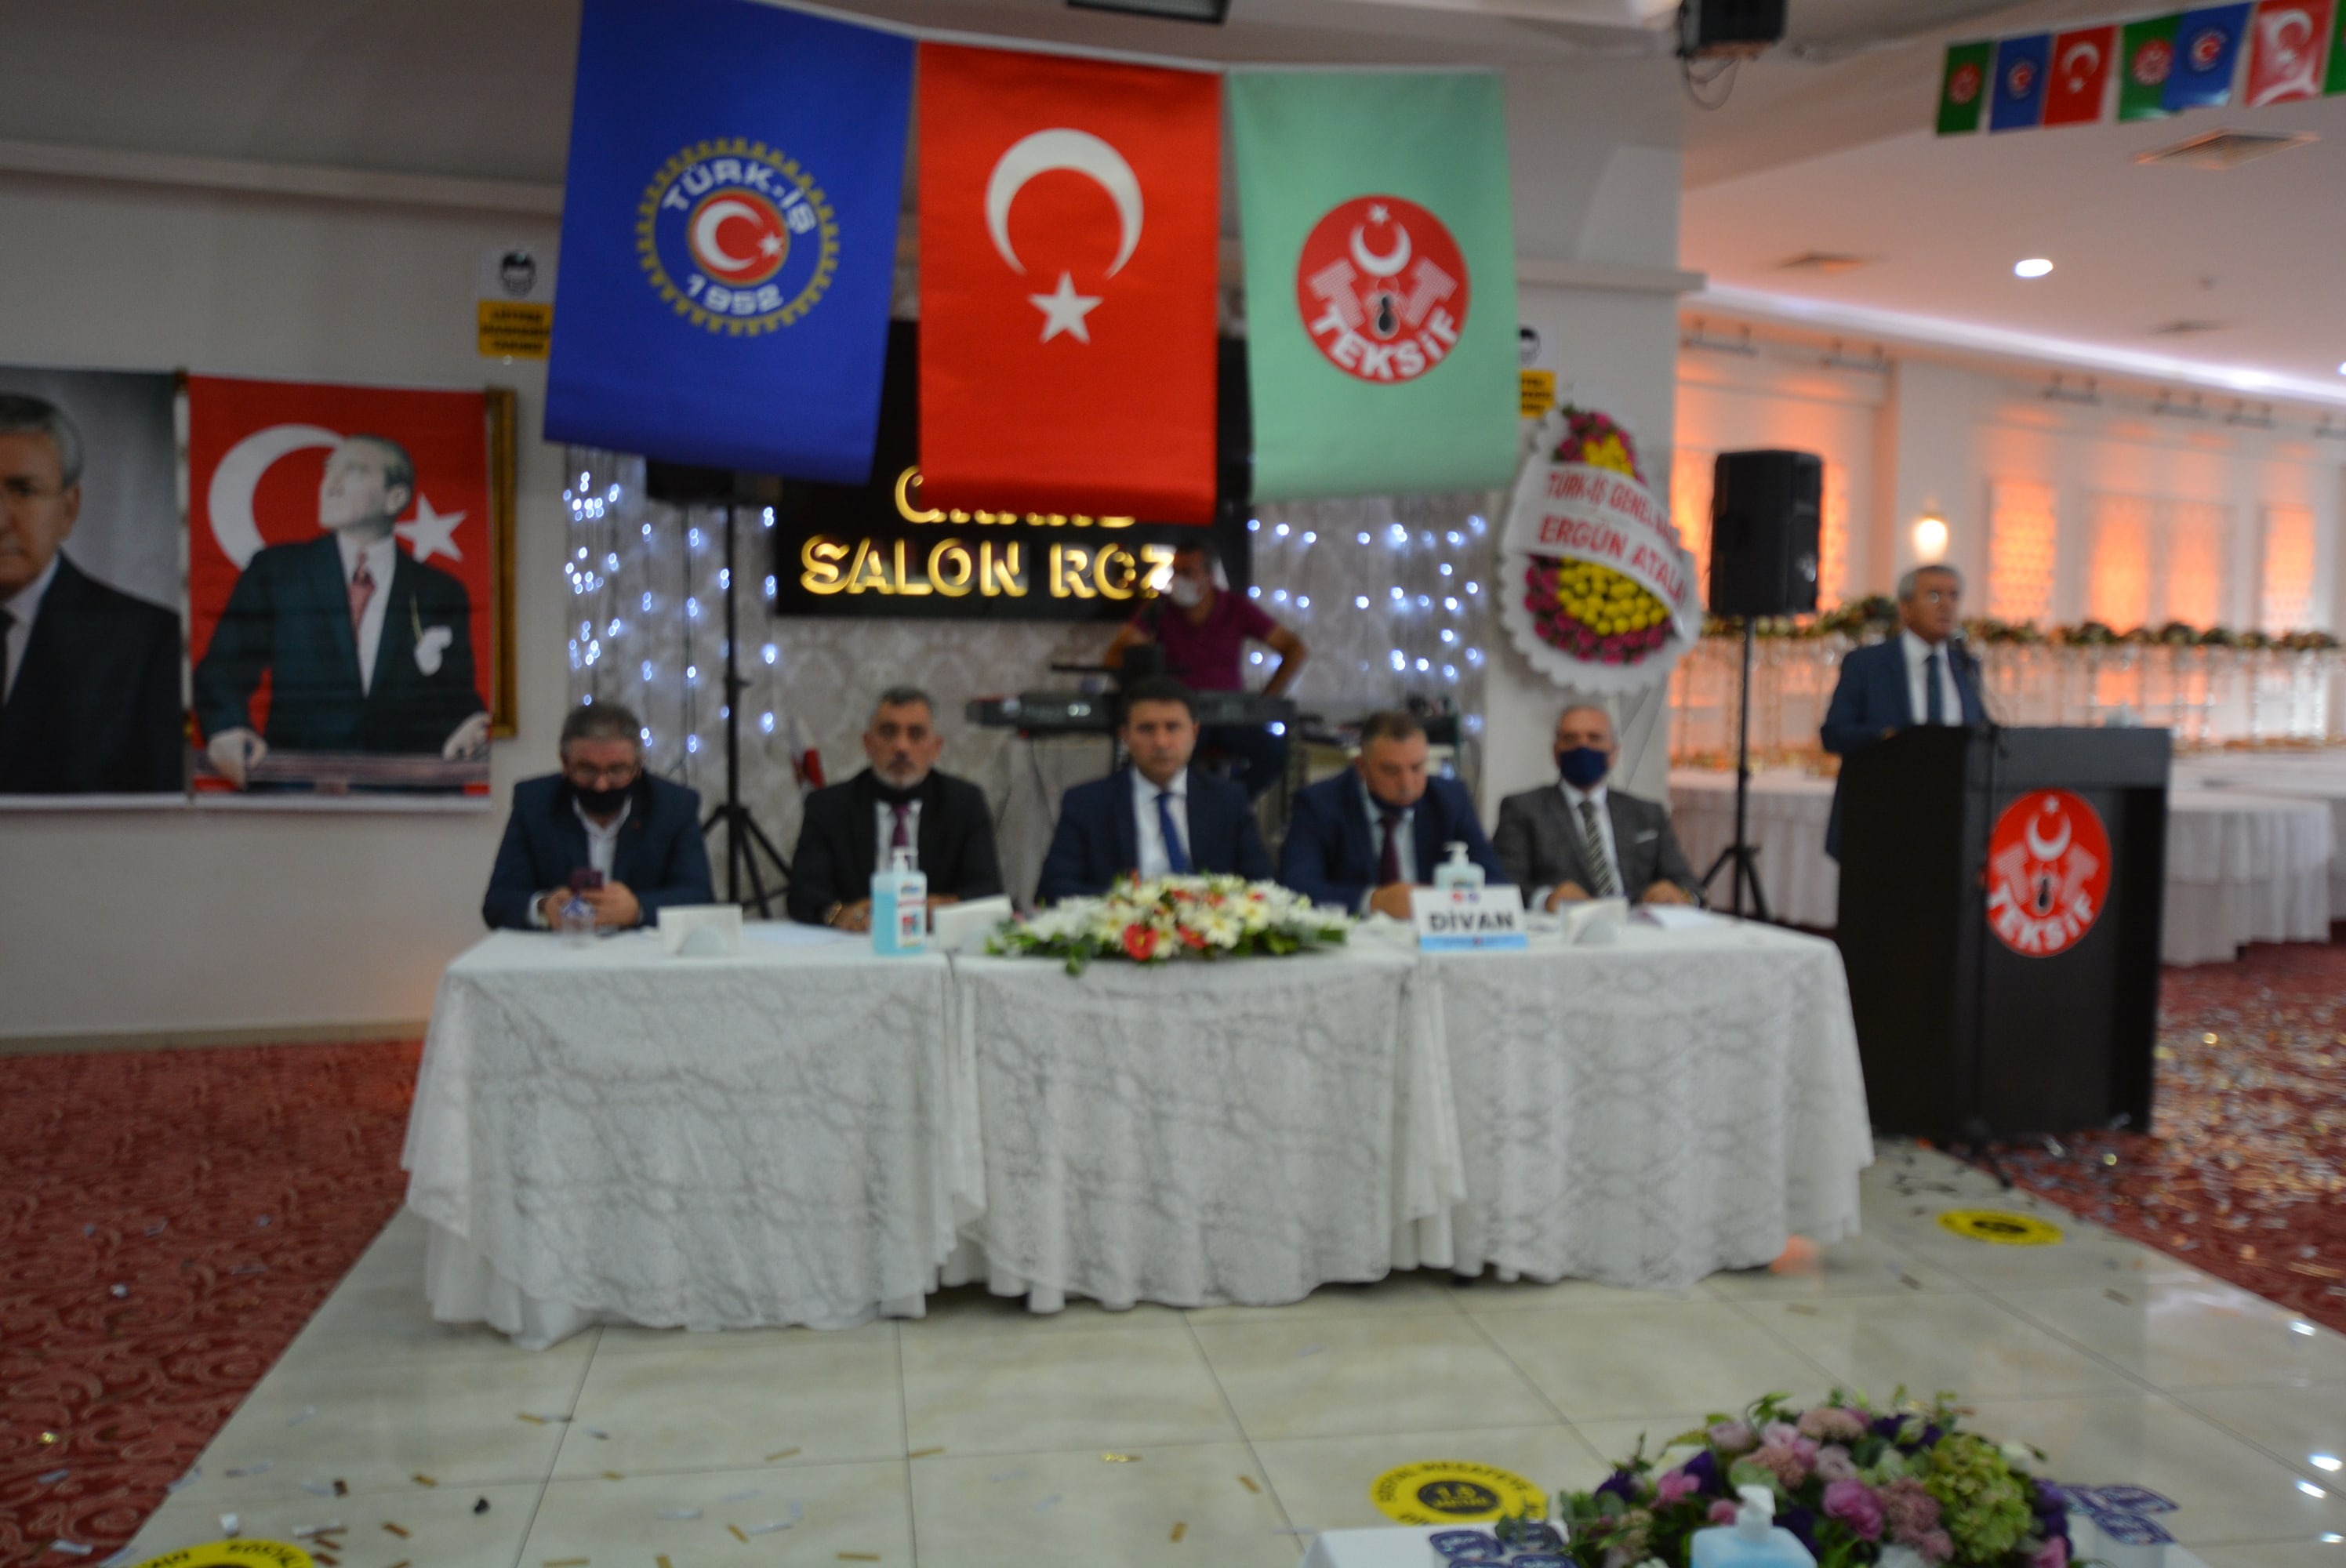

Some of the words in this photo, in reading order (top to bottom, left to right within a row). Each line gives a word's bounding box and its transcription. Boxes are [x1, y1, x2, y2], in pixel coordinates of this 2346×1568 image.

[687, 273, 783, 315] 1952
[1539, 514, 1629, 559] ERGÜN
[799, 534, 1030, 598] SALON
